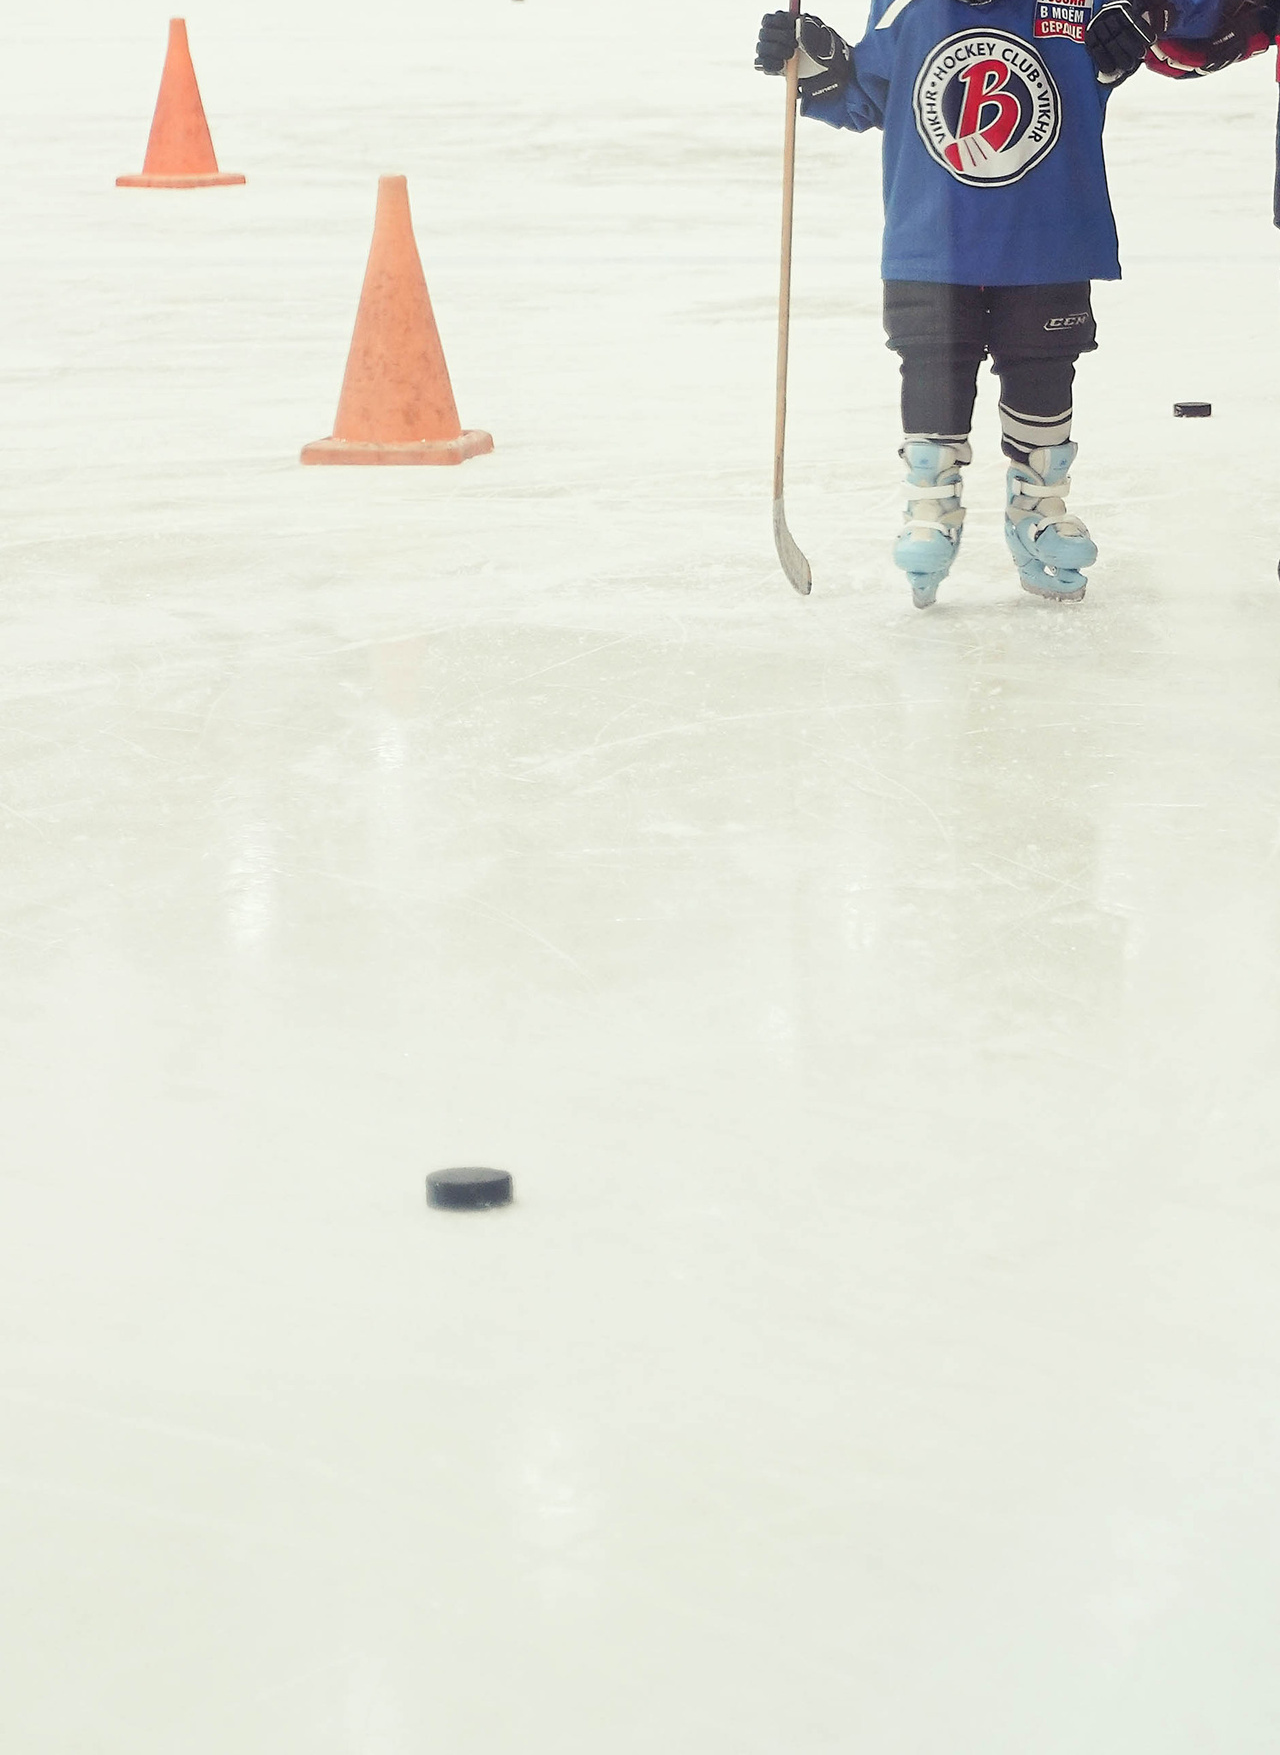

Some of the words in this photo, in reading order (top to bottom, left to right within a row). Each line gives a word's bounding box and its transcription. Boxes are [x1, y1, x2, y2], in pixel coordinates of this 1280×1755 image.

[1041, 20, 1083, 40] СЕРДЦЕ
[1052, 6, 1084, 23] МОЁМ
[934, 42, 996, 81] HOCKEY
[1002, 48, 1040, 83] CLUB
[925, 90, 946, 144] VIKHR
[1028, 89, 1051, 143] VIKHR
